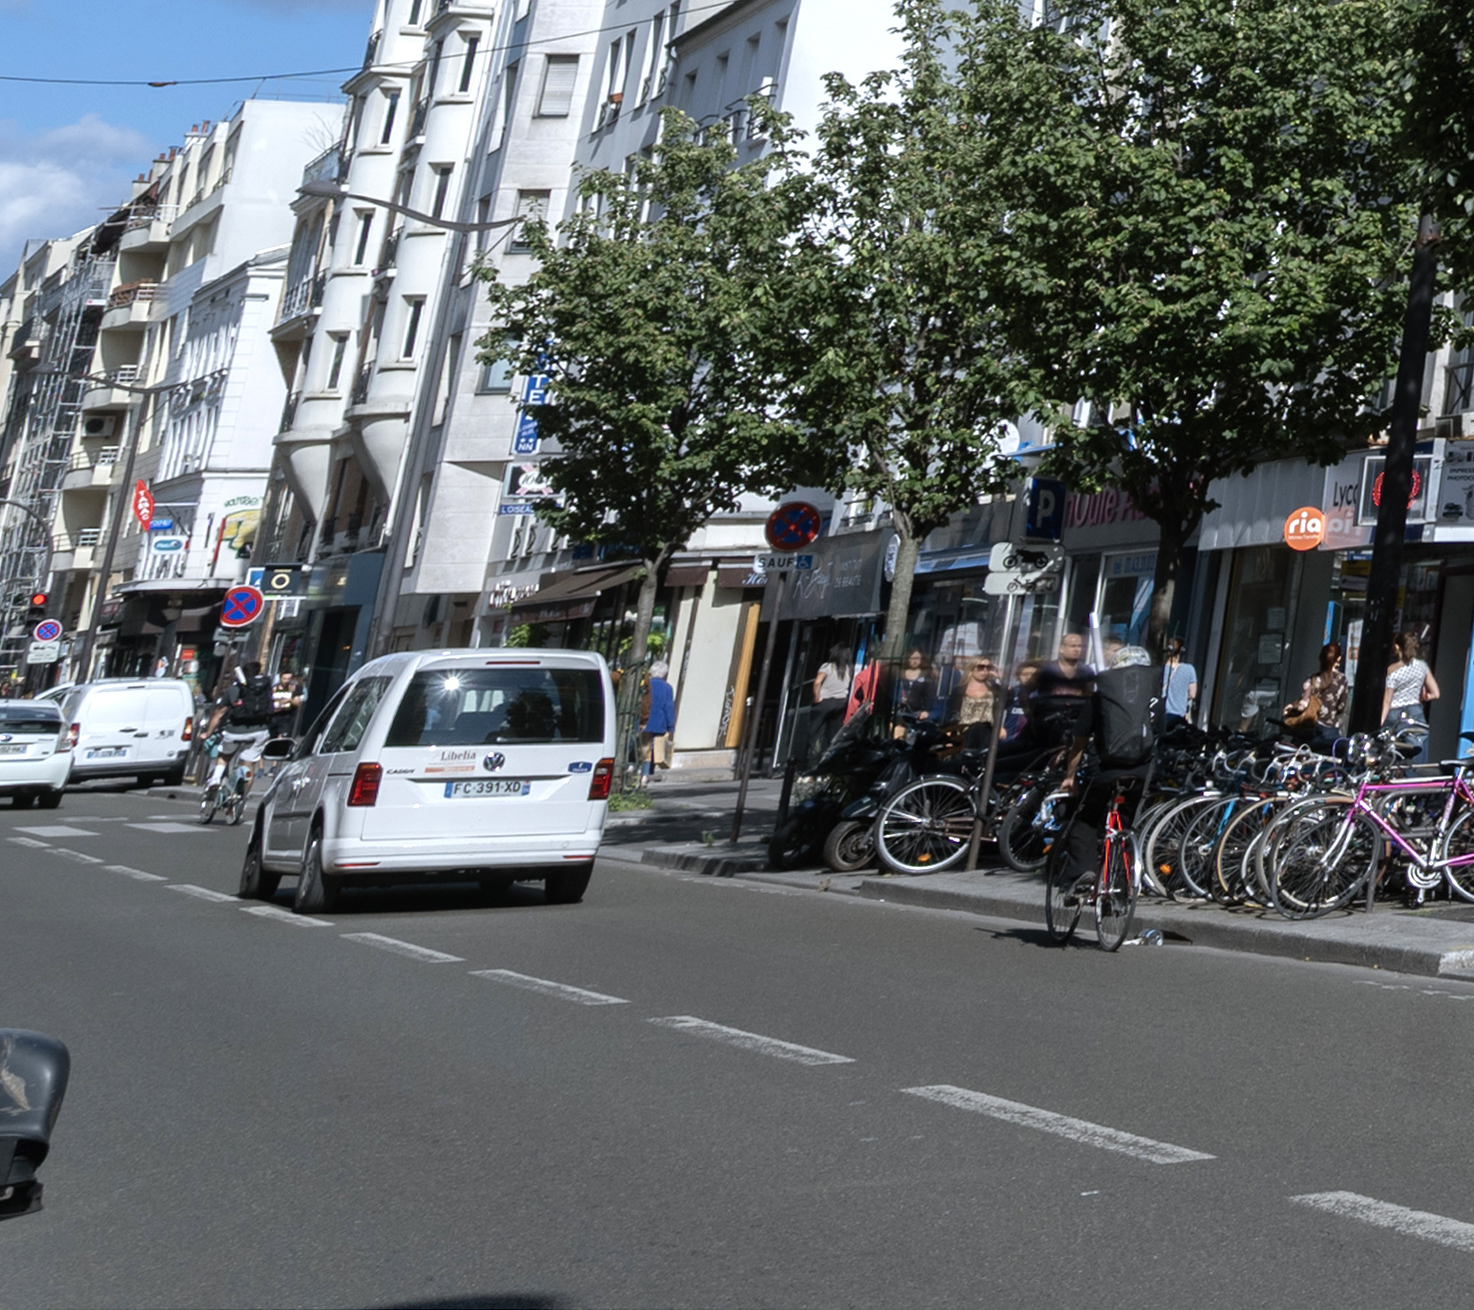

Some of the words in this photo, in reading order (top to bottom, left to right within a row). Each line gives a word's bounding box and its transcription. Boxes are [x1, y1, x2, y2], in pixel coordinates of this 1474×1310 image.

[138, 490, 151, 521] TABAC
[501, 505, 535, 514] L'OISEA
[1036, 489, 1055, 528] P
[1288, 511, 1321, 534] ria
[758, 557, 795, 569] SAUF
[440, 750, 477, 762] Libelia
[453, 781, 521, 795] FC-391-XD
